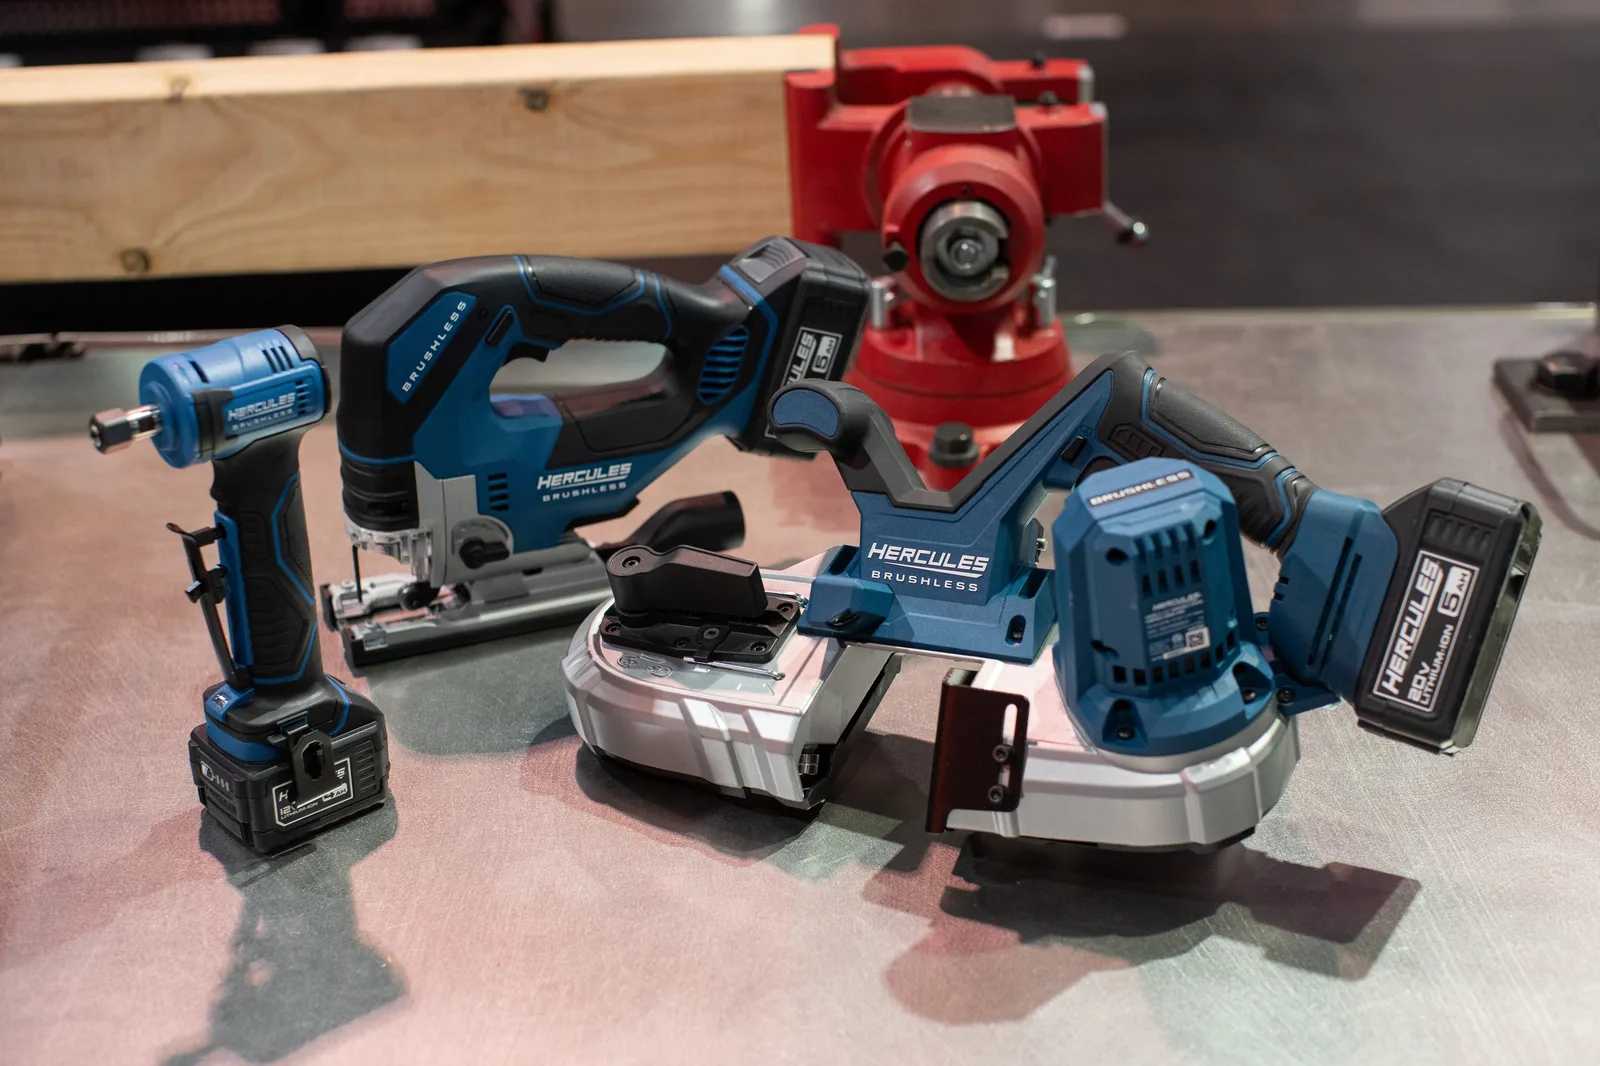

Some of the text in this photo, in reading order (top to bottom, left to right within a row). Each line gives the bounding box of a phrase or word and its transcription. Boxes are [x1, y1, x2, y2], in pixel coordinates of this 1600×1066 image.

[401, 301, 467, 392] BRUSHLESS
[787, 332, 816, 385] ULES
[227, 391, 296, 421] HERCULES
[231, 408, 294, 431] BRUSHLESS
[537, 462, 632, 490] HERCULES
[1089, 470, 1191, 506] BRUSHLESS
[542, 481, 627, 502] BRUSHLESS
[867, 542, 990, 572] HERCULES
[871, 570, 979, 592] BRUSHLESS
[1381, 557, 1442, 695] HERCULES
[1407, 661, 1432, 703] 20V
